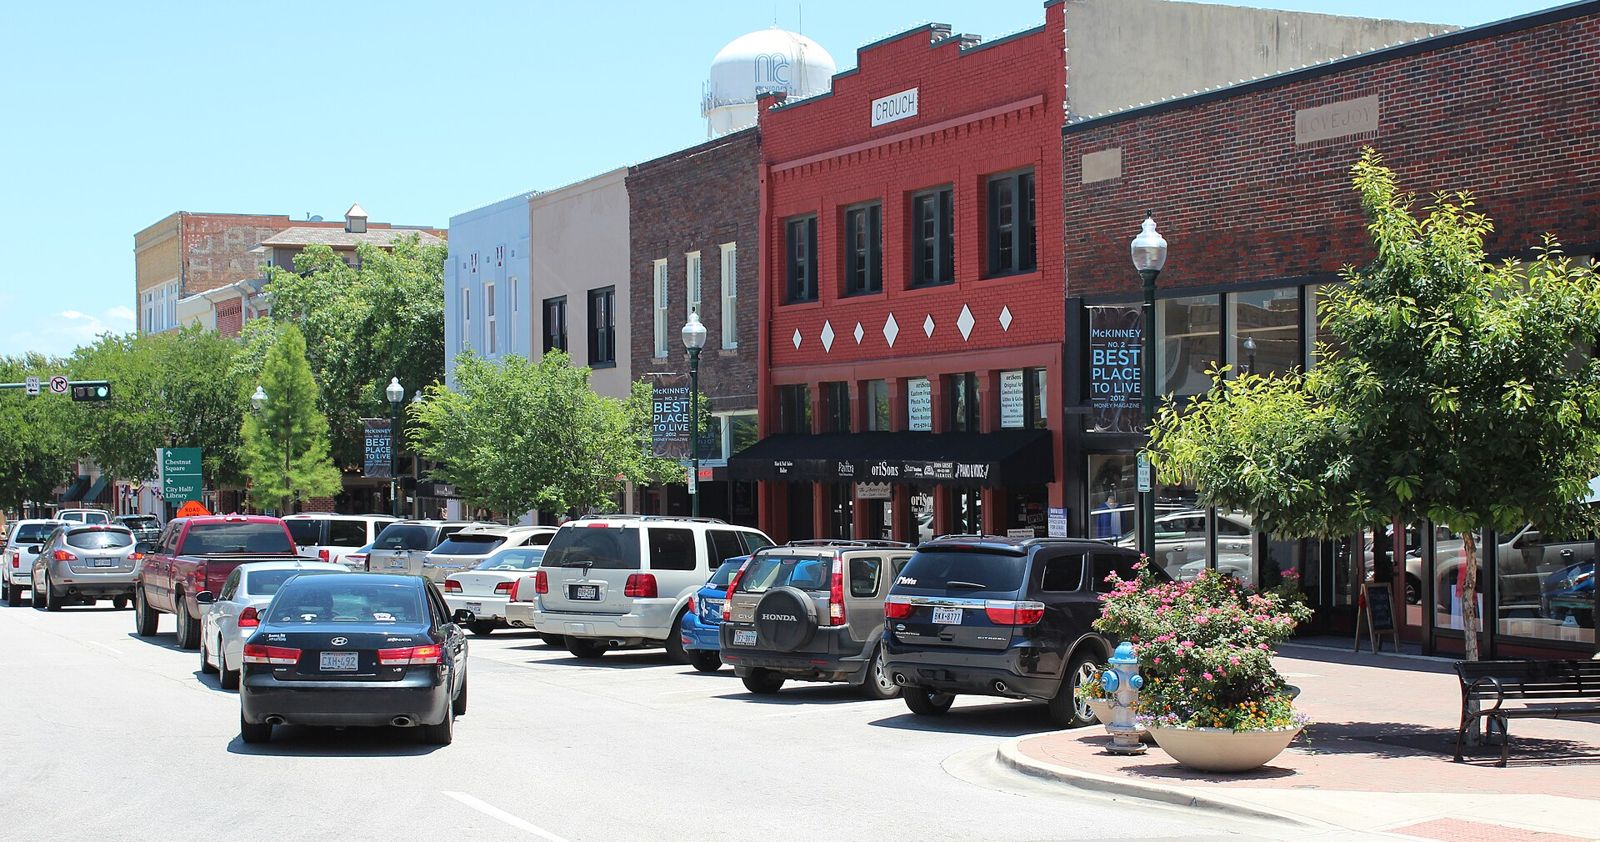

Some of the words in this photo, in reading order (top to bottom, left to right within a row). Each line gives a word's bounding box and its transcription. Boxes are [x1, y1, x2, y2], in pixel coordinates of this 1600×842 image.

[876, 93, 915, 121] CROUCH
[1300, 107, 1371, 134] LOVEJOY
[1092, 329, 1142, 338] McKINNEY
[1093, 349, 1141, 366] BEST
[1092, 368, 1141, 380] PLACE
[653, 387, 690, 395] McKINNEY
[1092, 382, 1110, 393] TO
[1114, 382, 1141, 393] LIVE
[654, 402, 689, 413] BEST
[653, 413, 689, 423] PLACE
[653, 424, 666, 432] TO
[669, 424, 689, 432] LIVE
[365, 438, 391, 447] BEST
[871, 461, 899, 476] oriSons
[762, 613, 798, 622] HONDA
